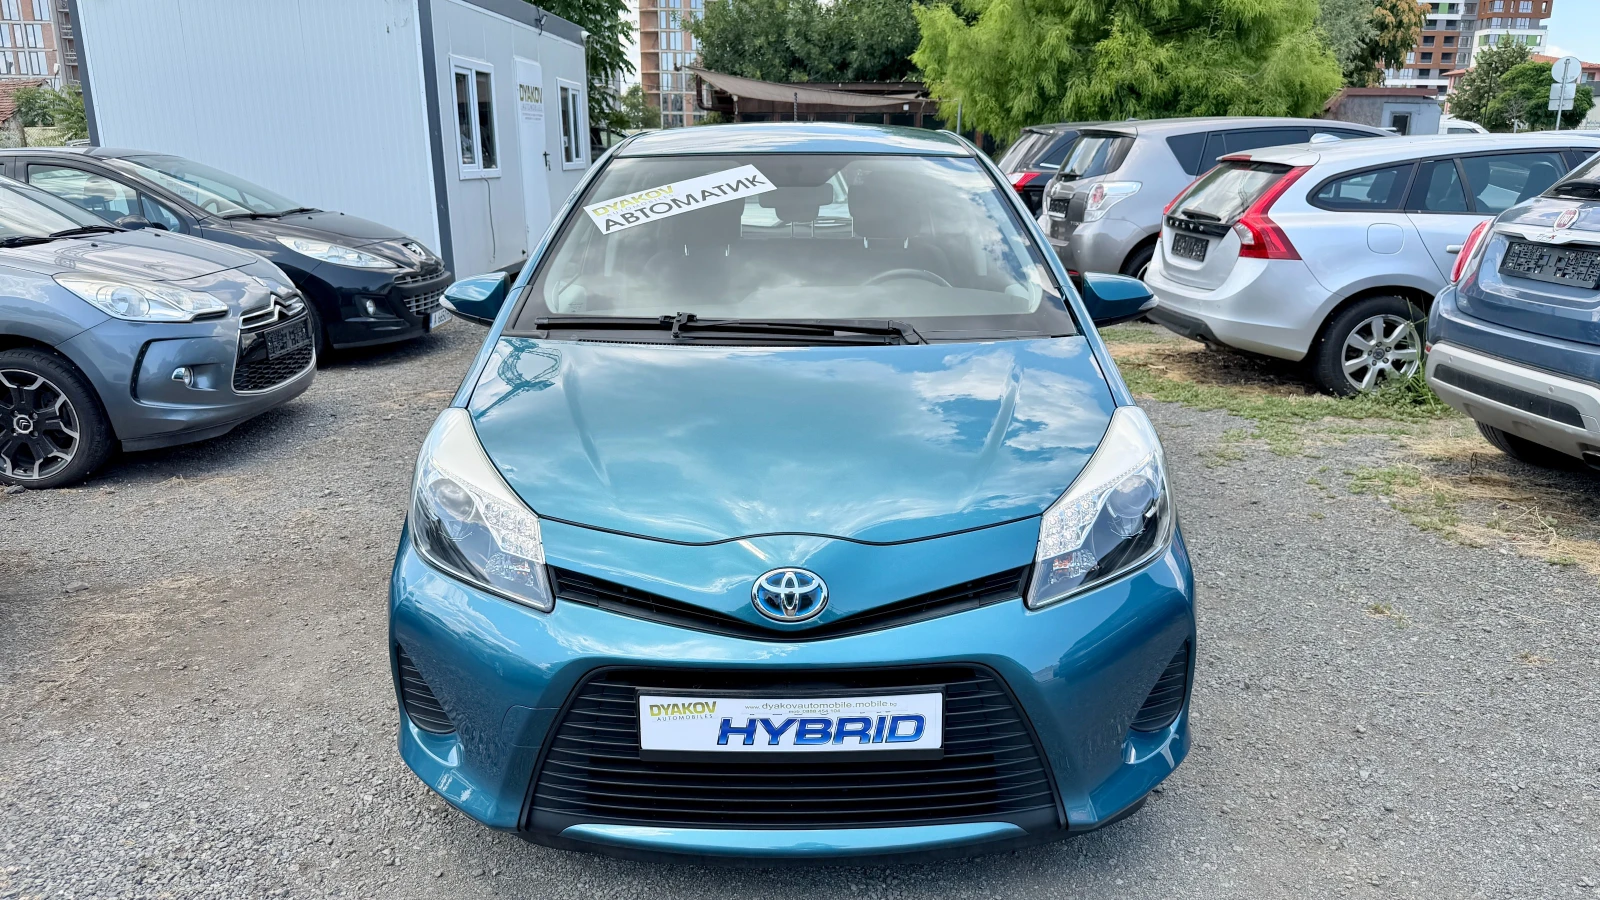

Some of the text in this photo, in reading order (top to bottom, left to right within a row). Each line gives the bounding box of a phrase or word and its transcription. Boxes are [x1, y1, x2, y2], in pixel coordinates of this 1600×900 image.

[519, 84, 542, 104] DYAKOV
[592, 185, 673, 216] DYAKOV
[605, 174, 766, 232] АВТОМАТИК
[607, 194, 674, 217] AUTOMOBILES
[649, 701, 717, 716] DYAKOV
[717, 714, 926, 746] HYBRID
